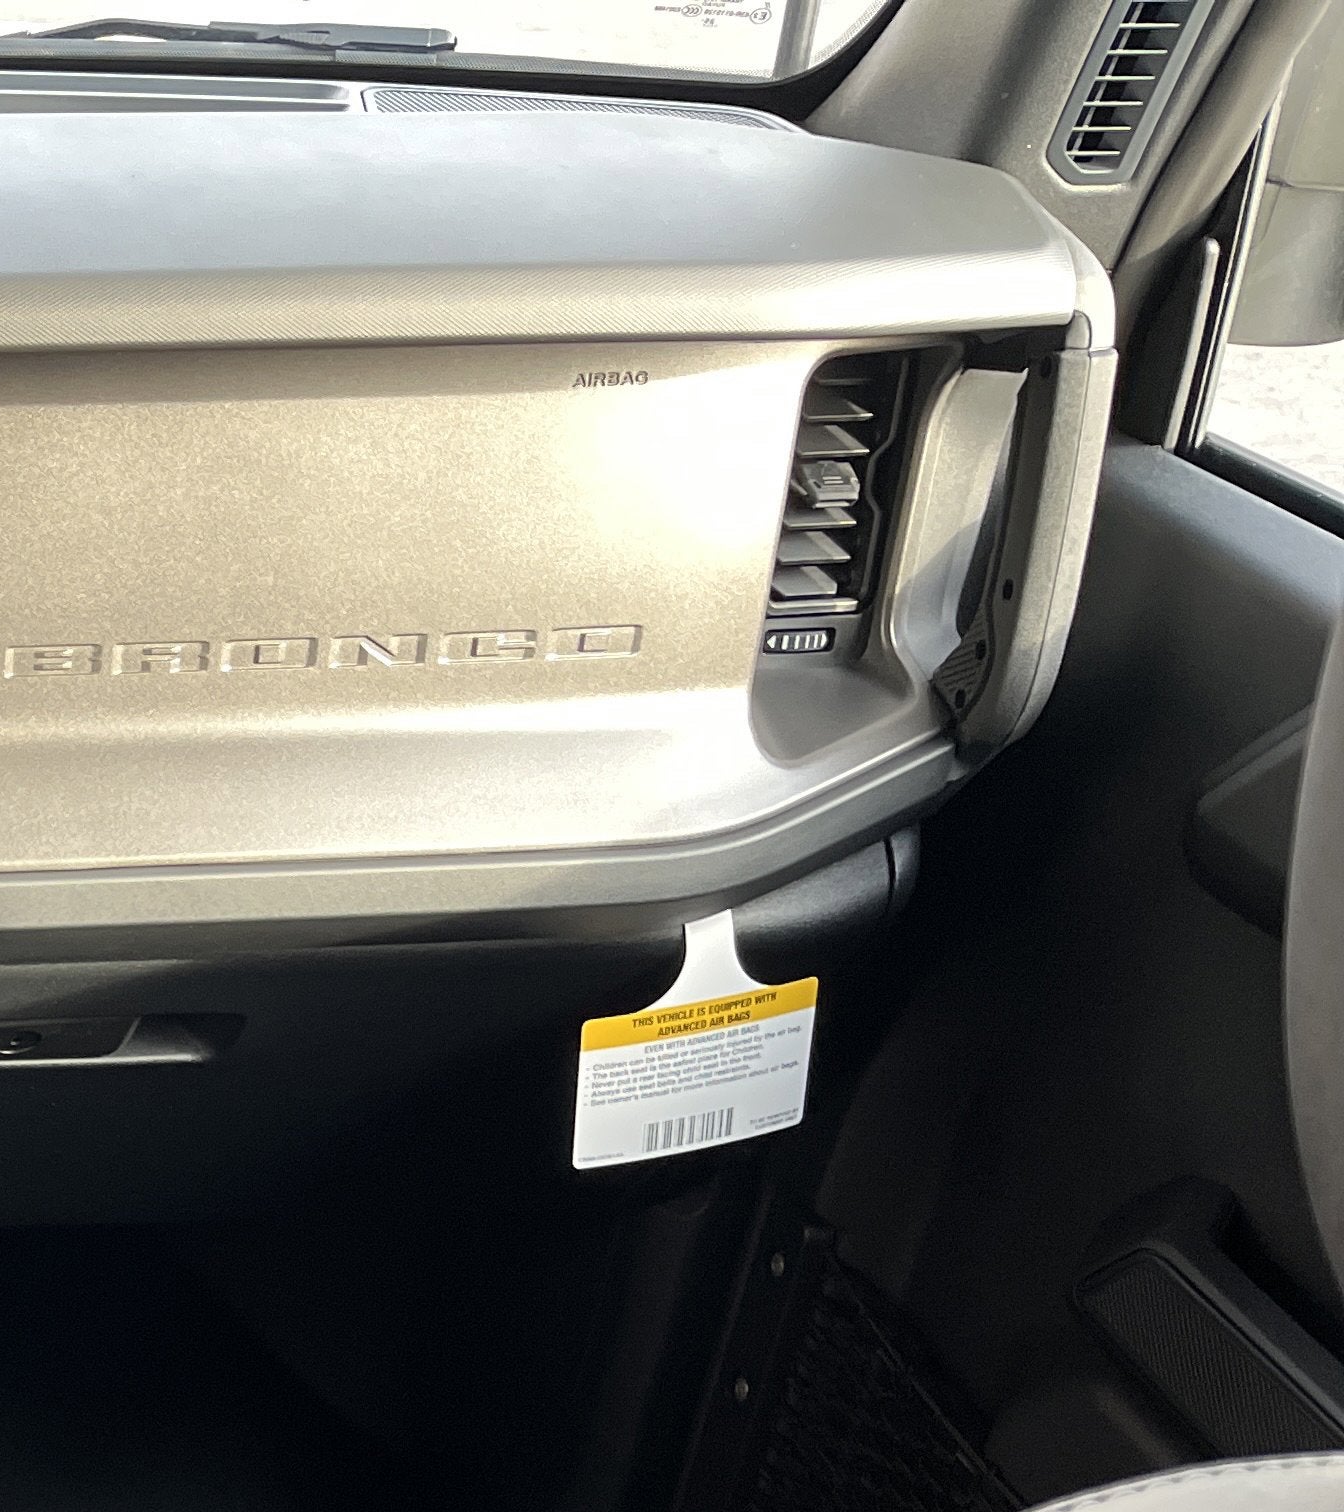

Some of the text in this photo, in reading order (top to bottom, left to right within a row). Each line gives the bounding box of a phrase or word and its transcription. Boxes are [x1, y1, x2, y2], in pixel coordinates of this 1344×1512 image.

[572, 370, 649, 388] AIRBAG
[3, 623, 646, 680] BRONCO
[632, 991, 778, 1029] THIS VEHICLE IS EQUIPPED WITH
[657, 1010, 751, 1038] ADVANCED AIR BAGS
